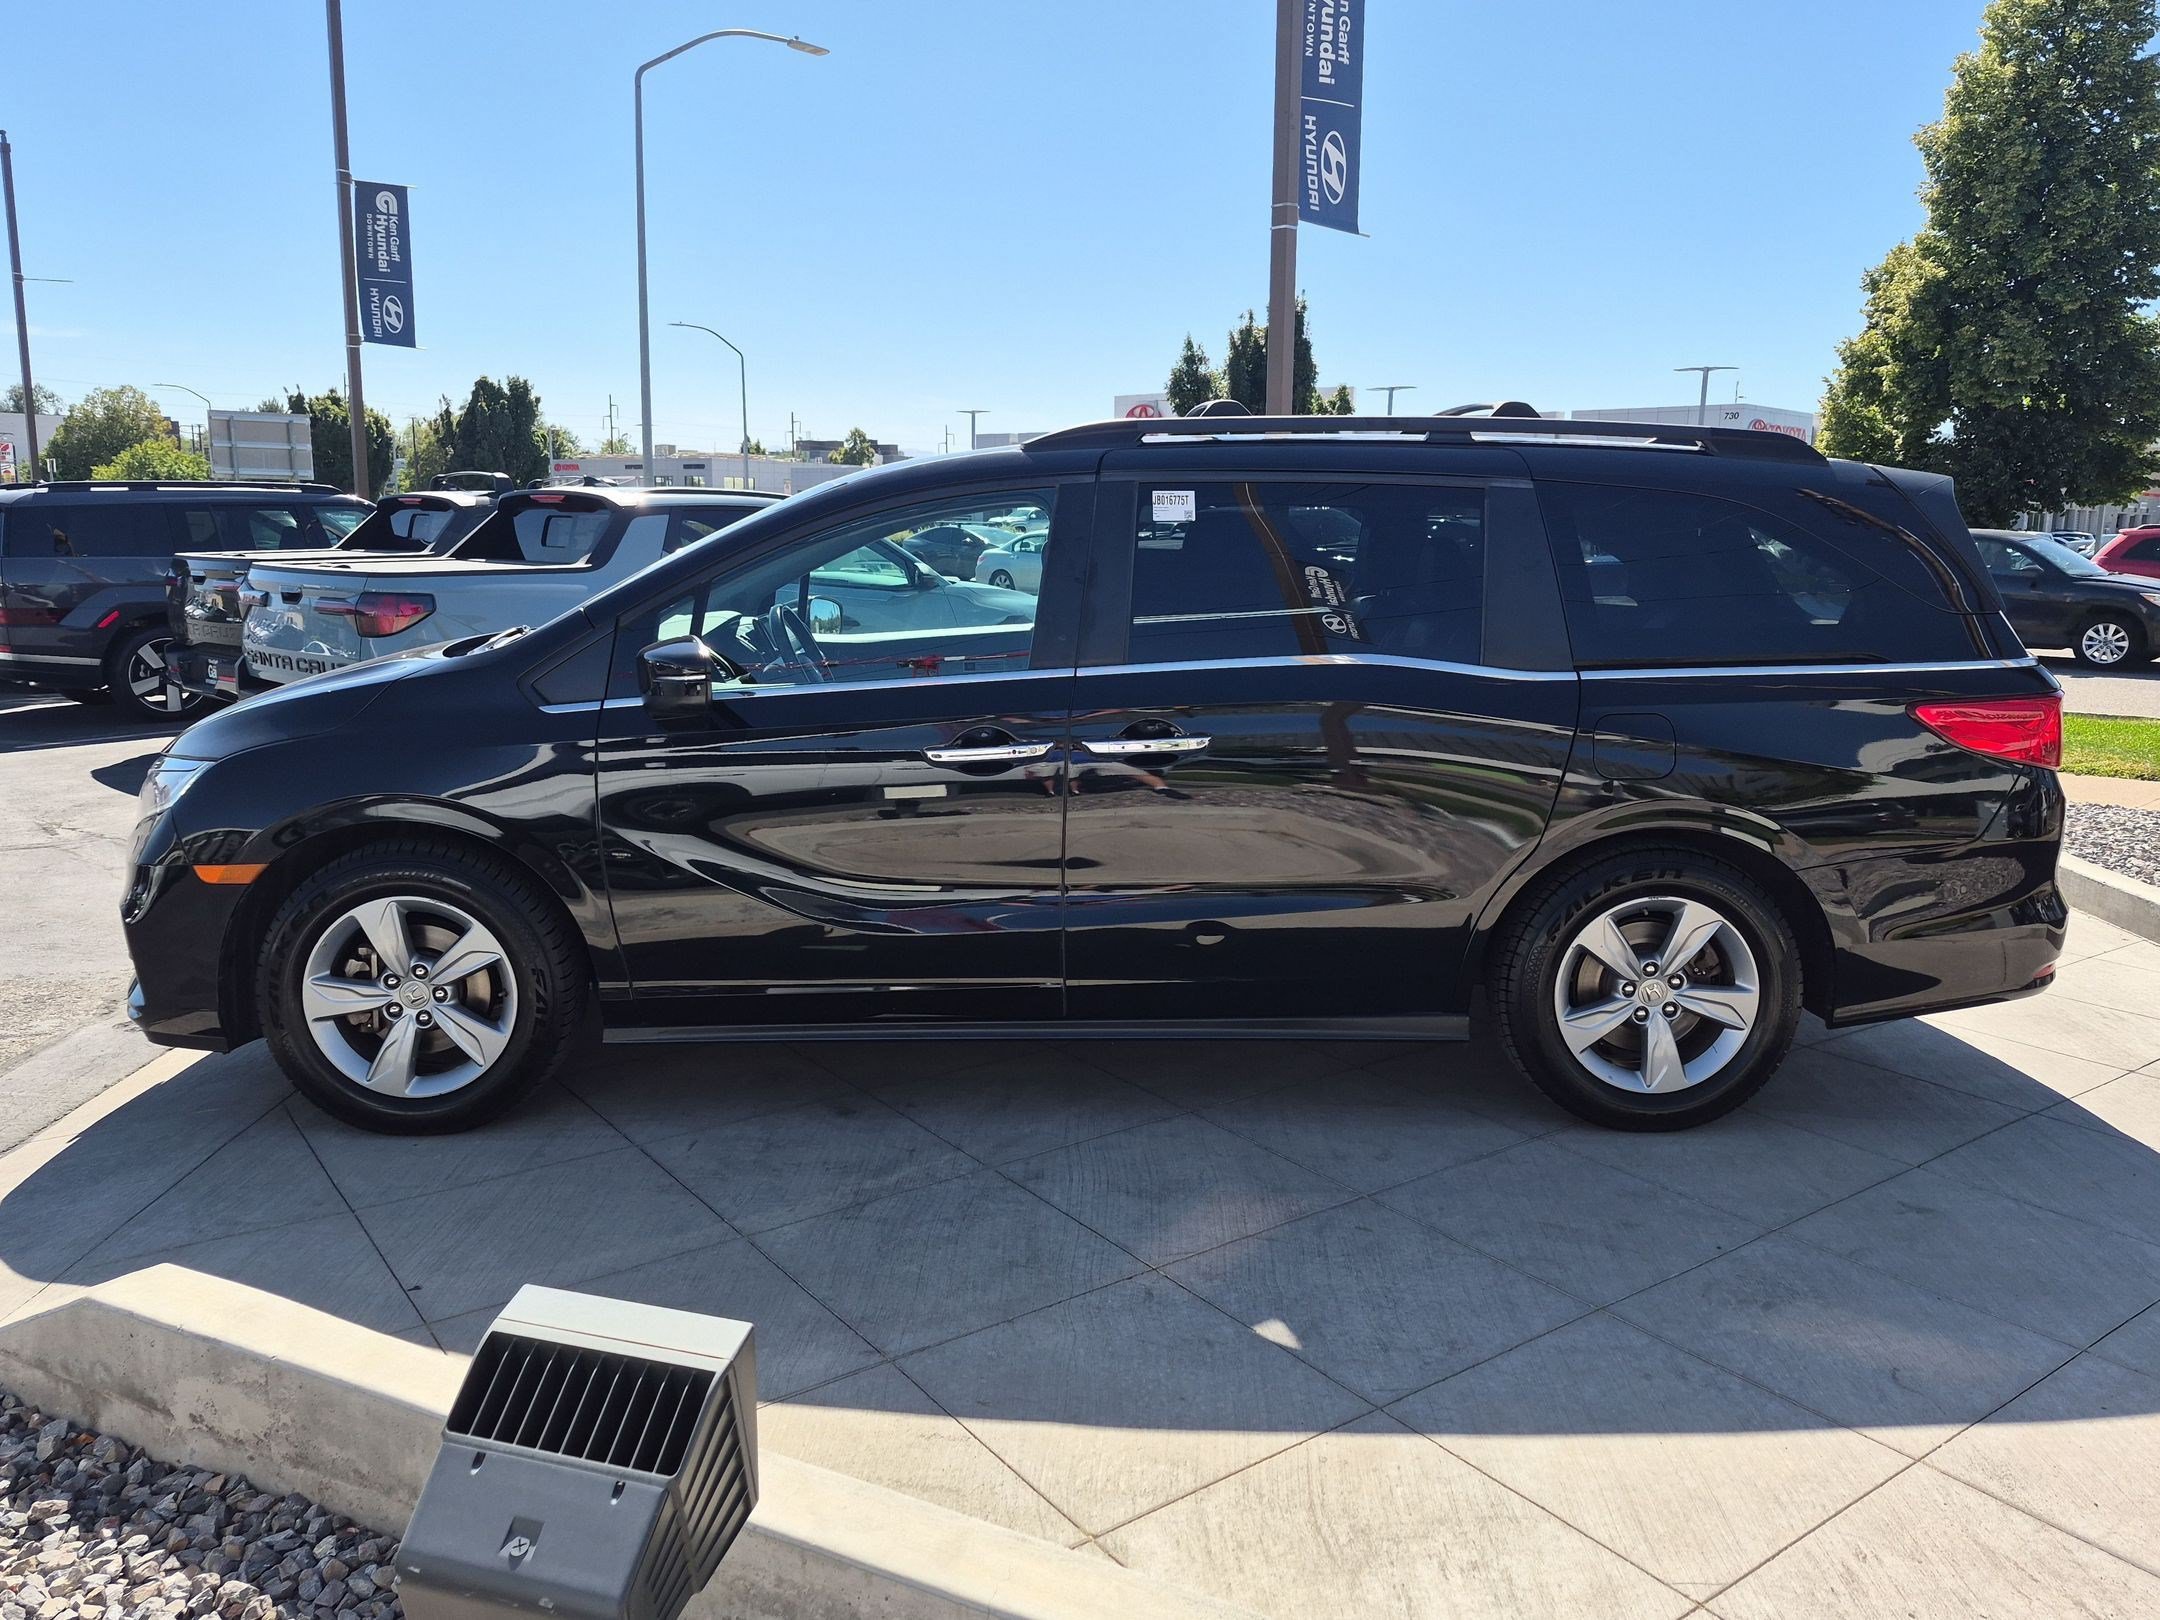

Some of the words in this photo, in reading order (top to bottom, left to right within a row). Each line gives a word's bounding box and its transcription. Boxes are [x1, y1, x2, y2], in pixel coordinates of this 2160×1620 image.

[1305, 0, 1316, 57] NTOWN
[1337, 16, 1350, 65] Garff
[1304, 114, 1320, 211] HYUNDAI
[366, 213, 374, 259] DOWNTOWN
[374, 213, 391, 273] Hyundai
[389, 215, 399, 236] Ken
[390, 236, 401, 262] Garff
[369, 287, 383, 338] HYUNDAI
[1724, 411, 1740, 420] 730
